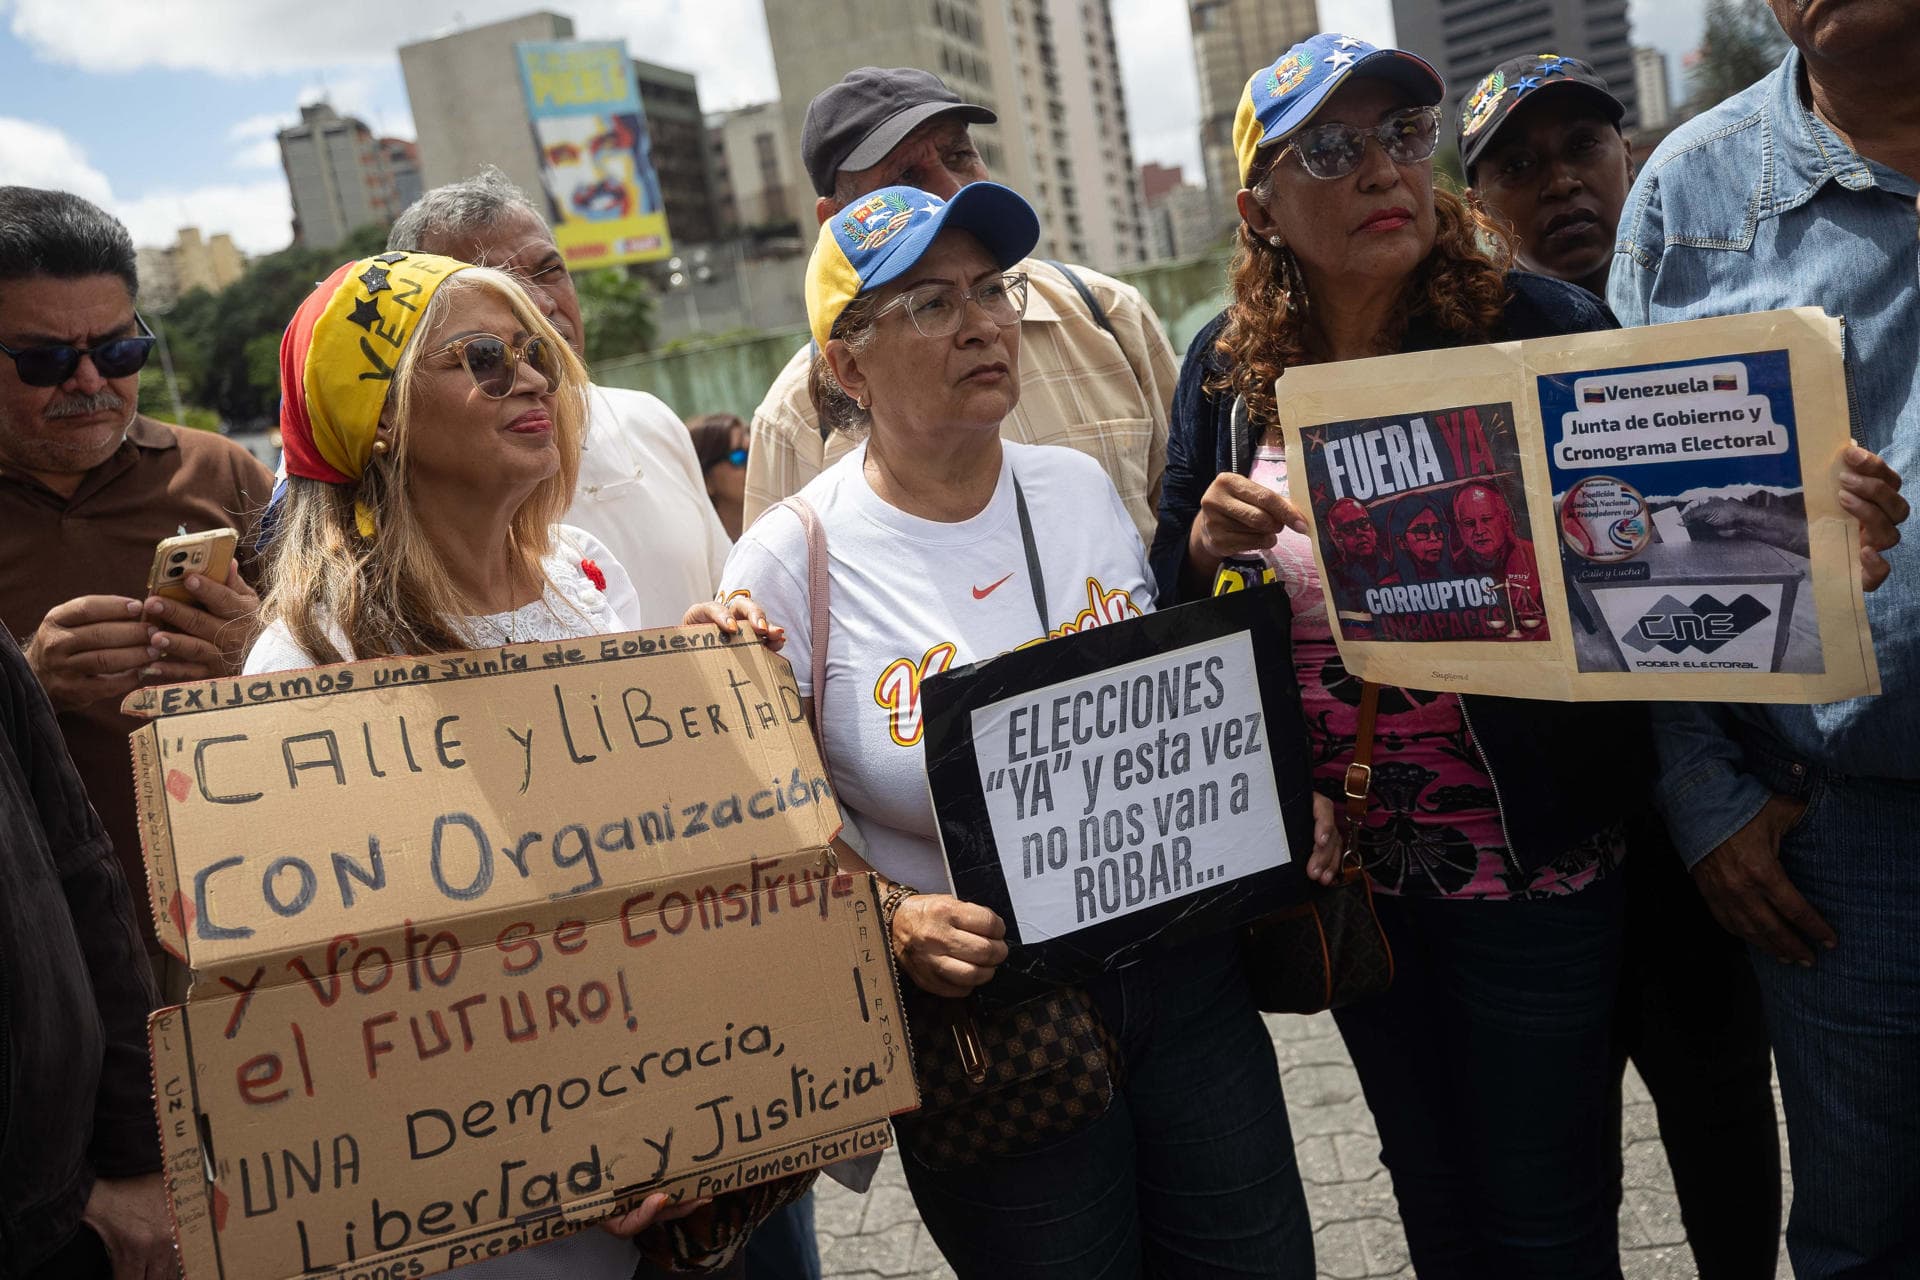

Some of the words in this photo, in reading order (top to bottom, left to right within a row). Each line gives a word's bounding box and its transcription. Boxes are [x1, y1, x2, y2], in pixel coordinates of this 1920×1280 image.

[1571, 415, 1622, 436] Junta
[1625, 412, 1649, 431] de
[1652, 408, 1745, 428] Gobierno
[1748, 406, 1762, 424] y
[1605, 375, 1709, 401] Venezuela
[1323, 417, 1445, 500] FUERA
[1435, 406, 1496, 478] YA
[1562, 442, 1678, 462] Cronograma
[1682, 430, 1776, 453] Electoral
[1365, 576, 1498, 615] CORRUPTOS
[1636, 612, 1740, 641] CNE
[373, 661, 431, 685] una
[441, 651, 527, 679] Junta
[543, 642, 585, 666] de
[1636, 660, 1681, 669] PODER
[1683, 660, 1759, 669] ELECTORAL
[1007, 655, 1225, 765] ELECCIONES
[507, 726, 533, 796] y
[1081, 754, 1104, 816] y
[1113, 728, 1191, 792] esta
[1200, 711, 1262, 767] vez
[193, 834, 386, 940] CON
[430, 767, 832, 903] Organización
[1021, 825, 1068, 880] no
[1078, 802, 1146, 862] nos
[1153, 778, 1220, 838] van
[1229, 771, 1250, 816] a
[1073, 835, 1225, 925] ROBAR...
[286, 918, 462, 1008] Voto
[235, 1022, 315, 1106] el
[361, 966, 638, 1080] FUTURO!
[406, 1022, 785, 1161] Democracia,
[642, 1126, 673, 1180] y
